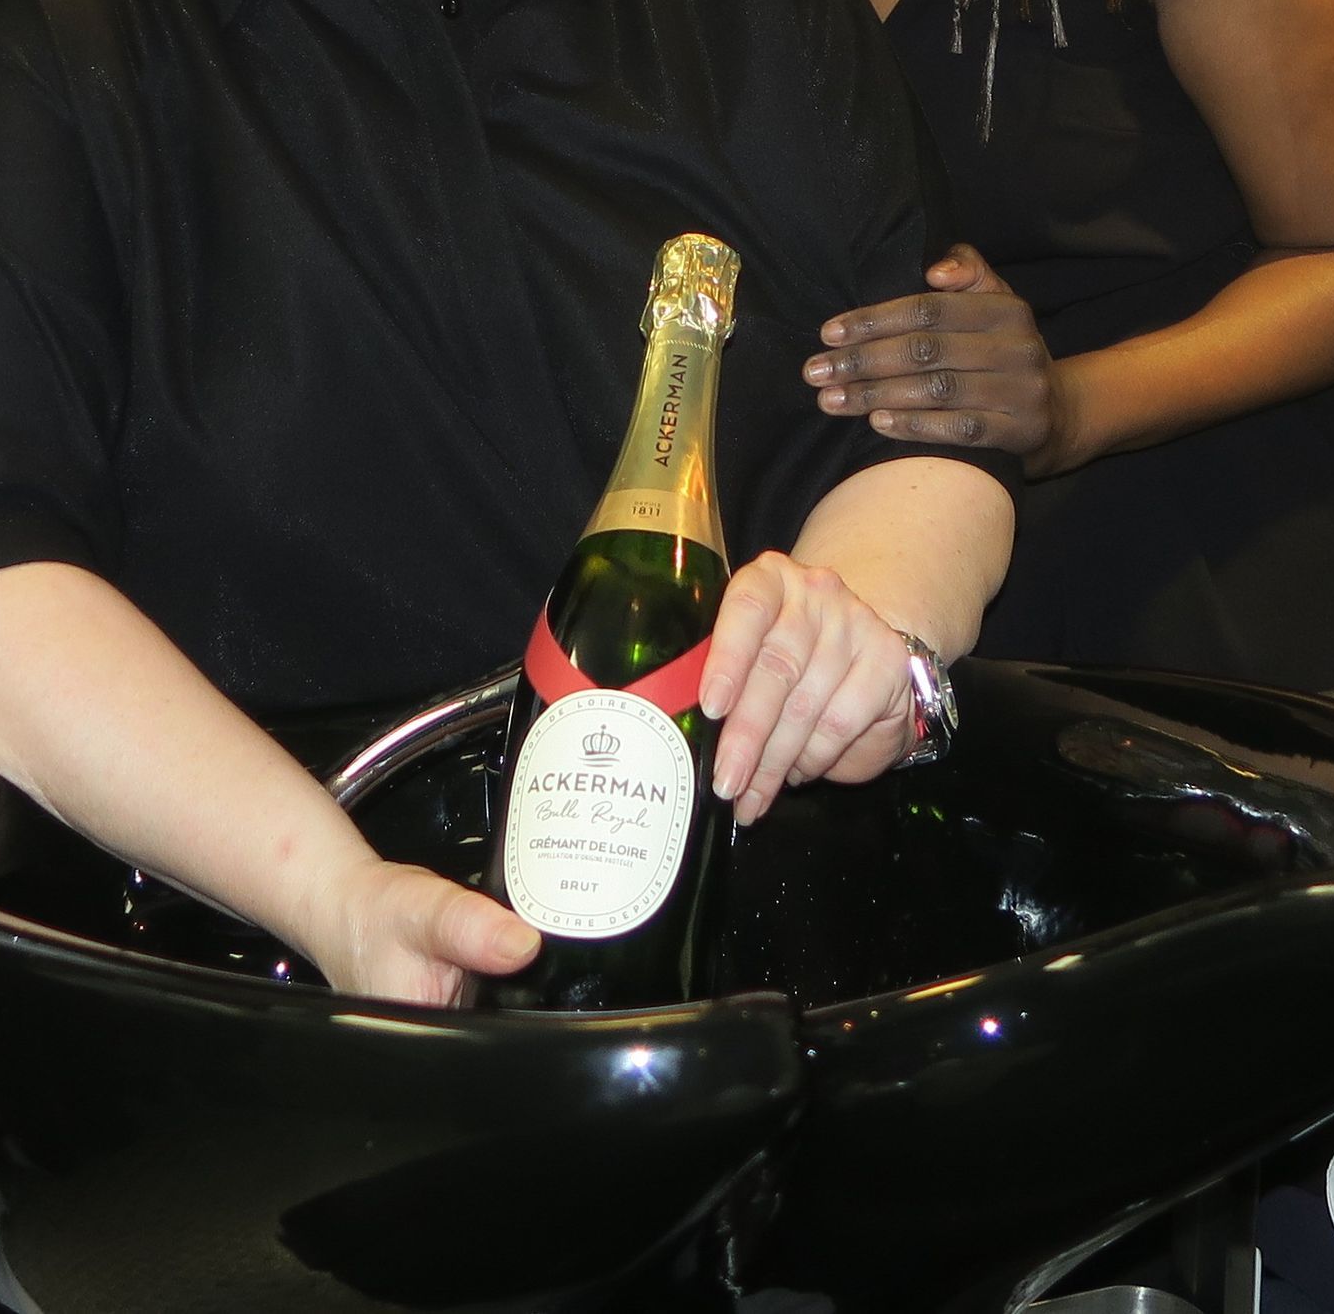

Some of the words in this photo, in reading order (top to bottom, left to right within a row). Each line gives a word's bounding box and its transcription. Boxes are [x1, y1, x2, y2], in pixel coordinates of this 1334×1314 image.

[654, 354, 688, 468] ACKERMAN
[631, 506, 661, 517] 1811
[549, 708, 565, 723] DE
[577, 699, 628, 709] LOIRE
[639, 709, 685, 762] DEPUIS
[527, 772, 667, 805] ACKERMAN
[535, 799, 580, 821] Bulle
[590, 800, 651, 834] Royale
[529, 835, 588, 851] CRÉMANT
[589, 841, 607, 853] DE
[609, 844, 648, 861] LOIRE
[520, 893, 533, 911] DE
[542, 911, 595, 927] LOIRE
[610, 880, 663, 925] DEPUIS
[560, 880, 599, 893] BRUT
